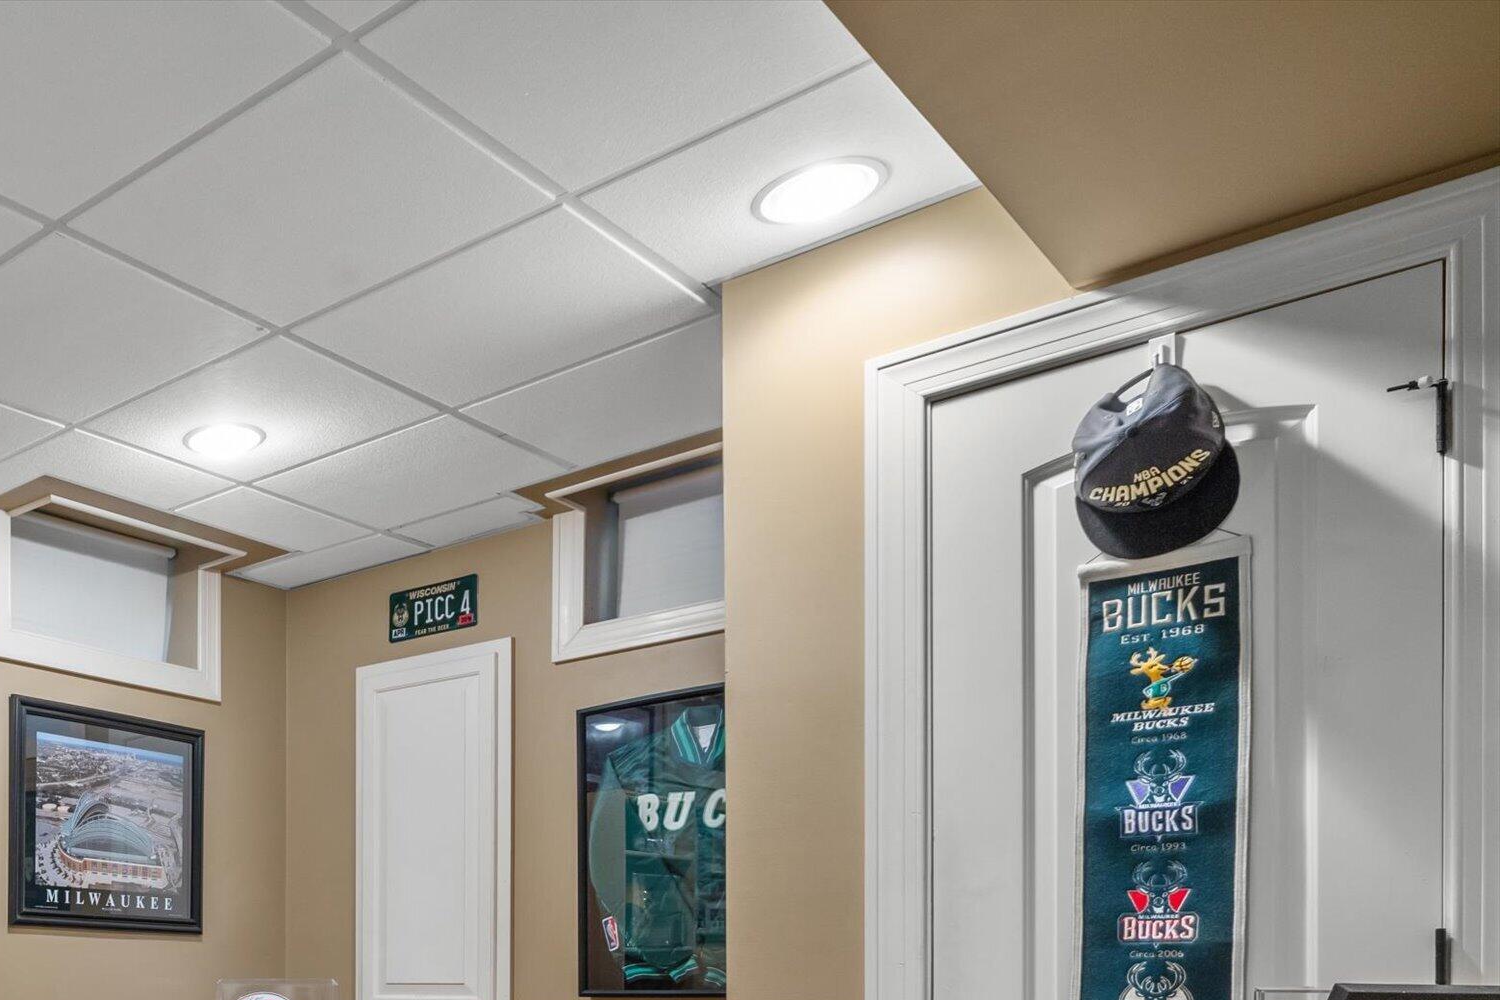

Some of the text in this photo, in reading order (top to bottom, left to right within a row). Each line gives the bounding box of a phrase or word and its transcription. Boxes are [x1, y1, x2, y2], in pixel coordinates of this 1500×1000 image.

[1088, 448, 1211, 502] CHAMPIONS
[1133, 466, 1160, 482] NBA
[408, 581, 457, 600] WISCONSIN
[1127, 571, 1201, 595] MILWAUKEE
[413, 589, 471, 626] PICC 4
[1102, 582, 1226, 632] BUCKS
[1161, 623, 1206, 639] 1968
[1111, 702, 1216, 723] MILWAUKEE
[1132, 716, 1190, 732] BUCKS
[1160, 731, 1187, 742] 1968
[1124, 805, 1195, 834] BUCKS
[1161, 842, 1186, 850] 1993
[46, 889, 173, 911] MILWAUKEE
[1123, 915, 1196, 940] BUCKS
[1129, 949, 1184, 958] Circa 2006
